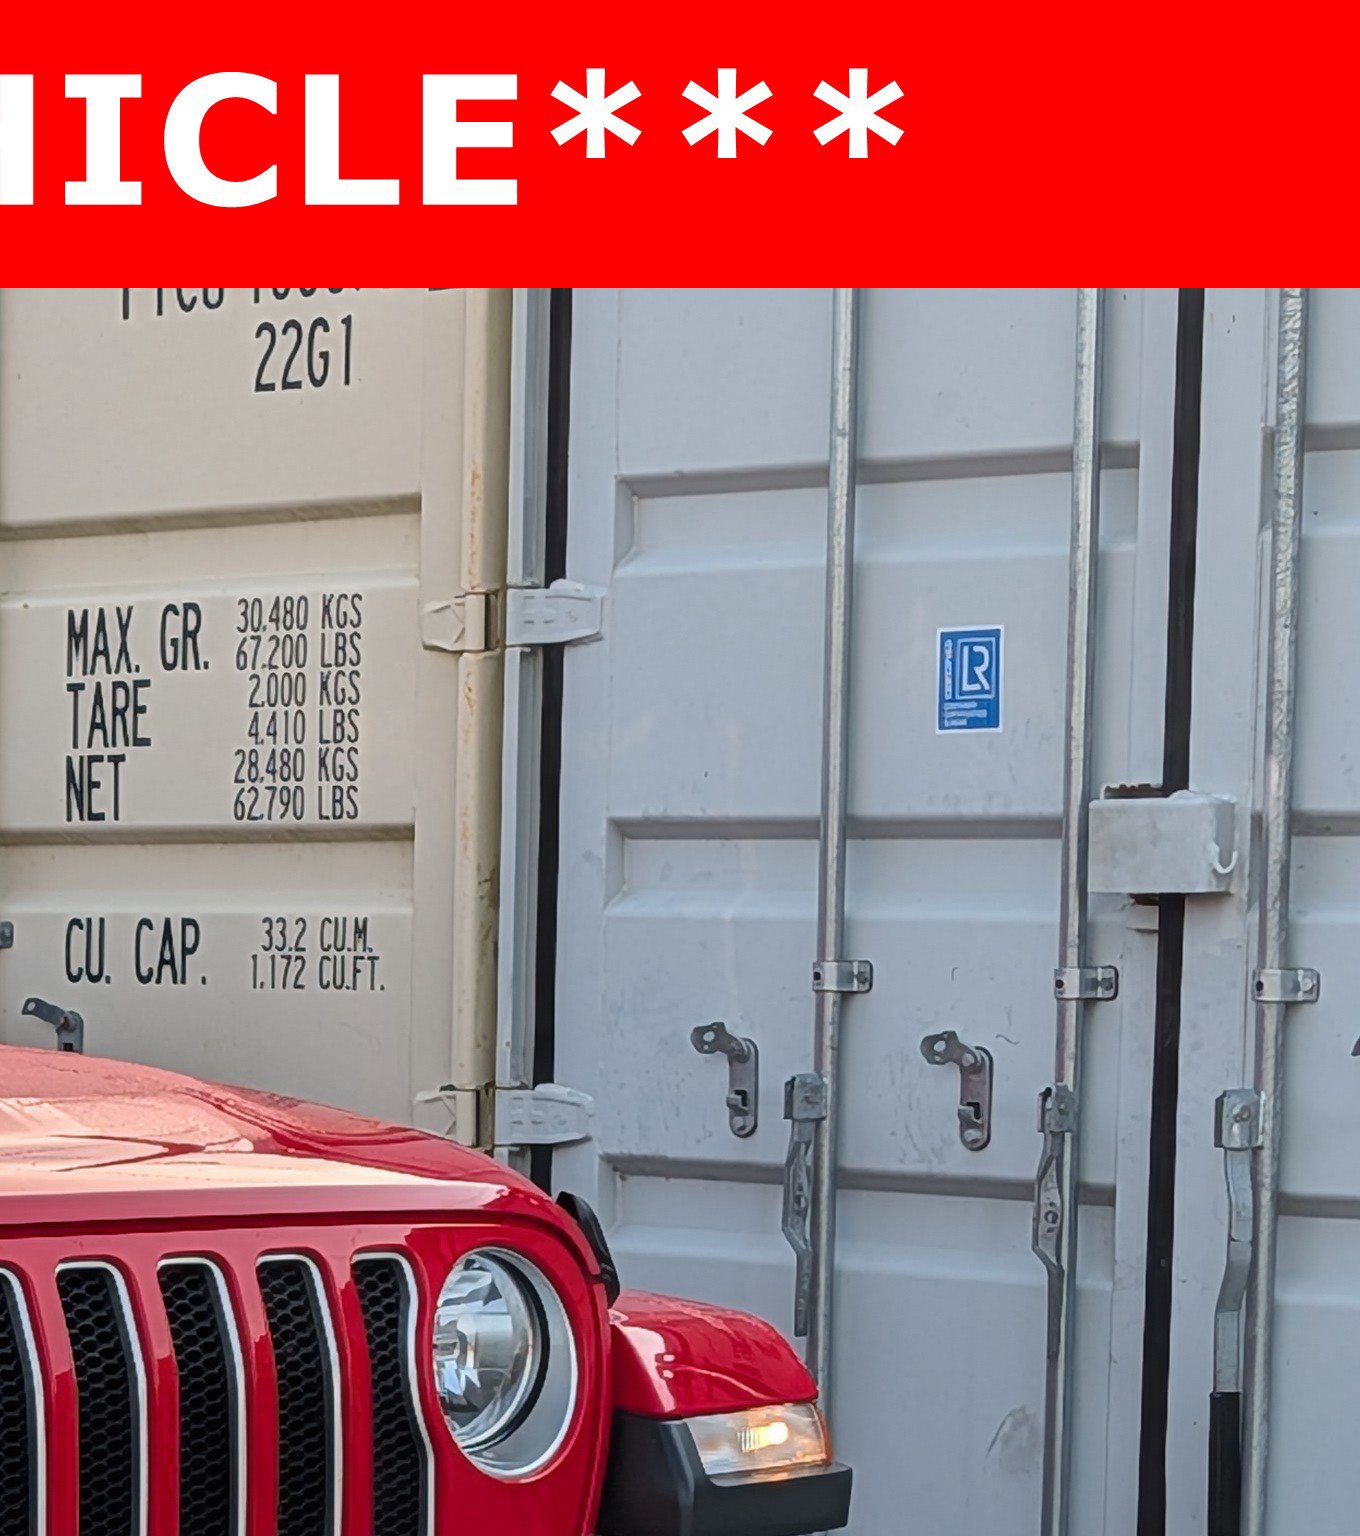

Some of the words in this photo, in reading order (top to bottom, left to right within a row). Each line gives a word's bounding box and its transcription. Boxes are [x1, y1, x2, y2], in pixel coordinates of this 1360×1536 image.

[254, 314, 353, 393] 22G1
[236, 595, 309, 634] 30.480
[321, 593, 363, 630] KGS
[66, 605, 141, 677] MAX.
[160, 602, 211, 672] GR.
[235, 633, 308, 671] 67.200
[320, 631, 362, 668] LBS
[319, 669, 361, 706] KGS
[962, 645, 990, 690] LR
[66, 678, 152, 750] TARE
[318, 708, 360, 745] LBS
[233, 747, 305, 784] 28.480
[318, 746, 359, 782] KGS
[65, 753, 127, 823] NET
[317, 785, 359, 821] LBS
[65, 916, 112, 985] CU.
[134, 916, 208, 986] CAP.
[261, 916, 307, 952] 33.2
[319, 916, 374, 953] CU.M.
[251, 953, 306, 990] 1.172
[318, 954, 385, 991] CU.FT.
